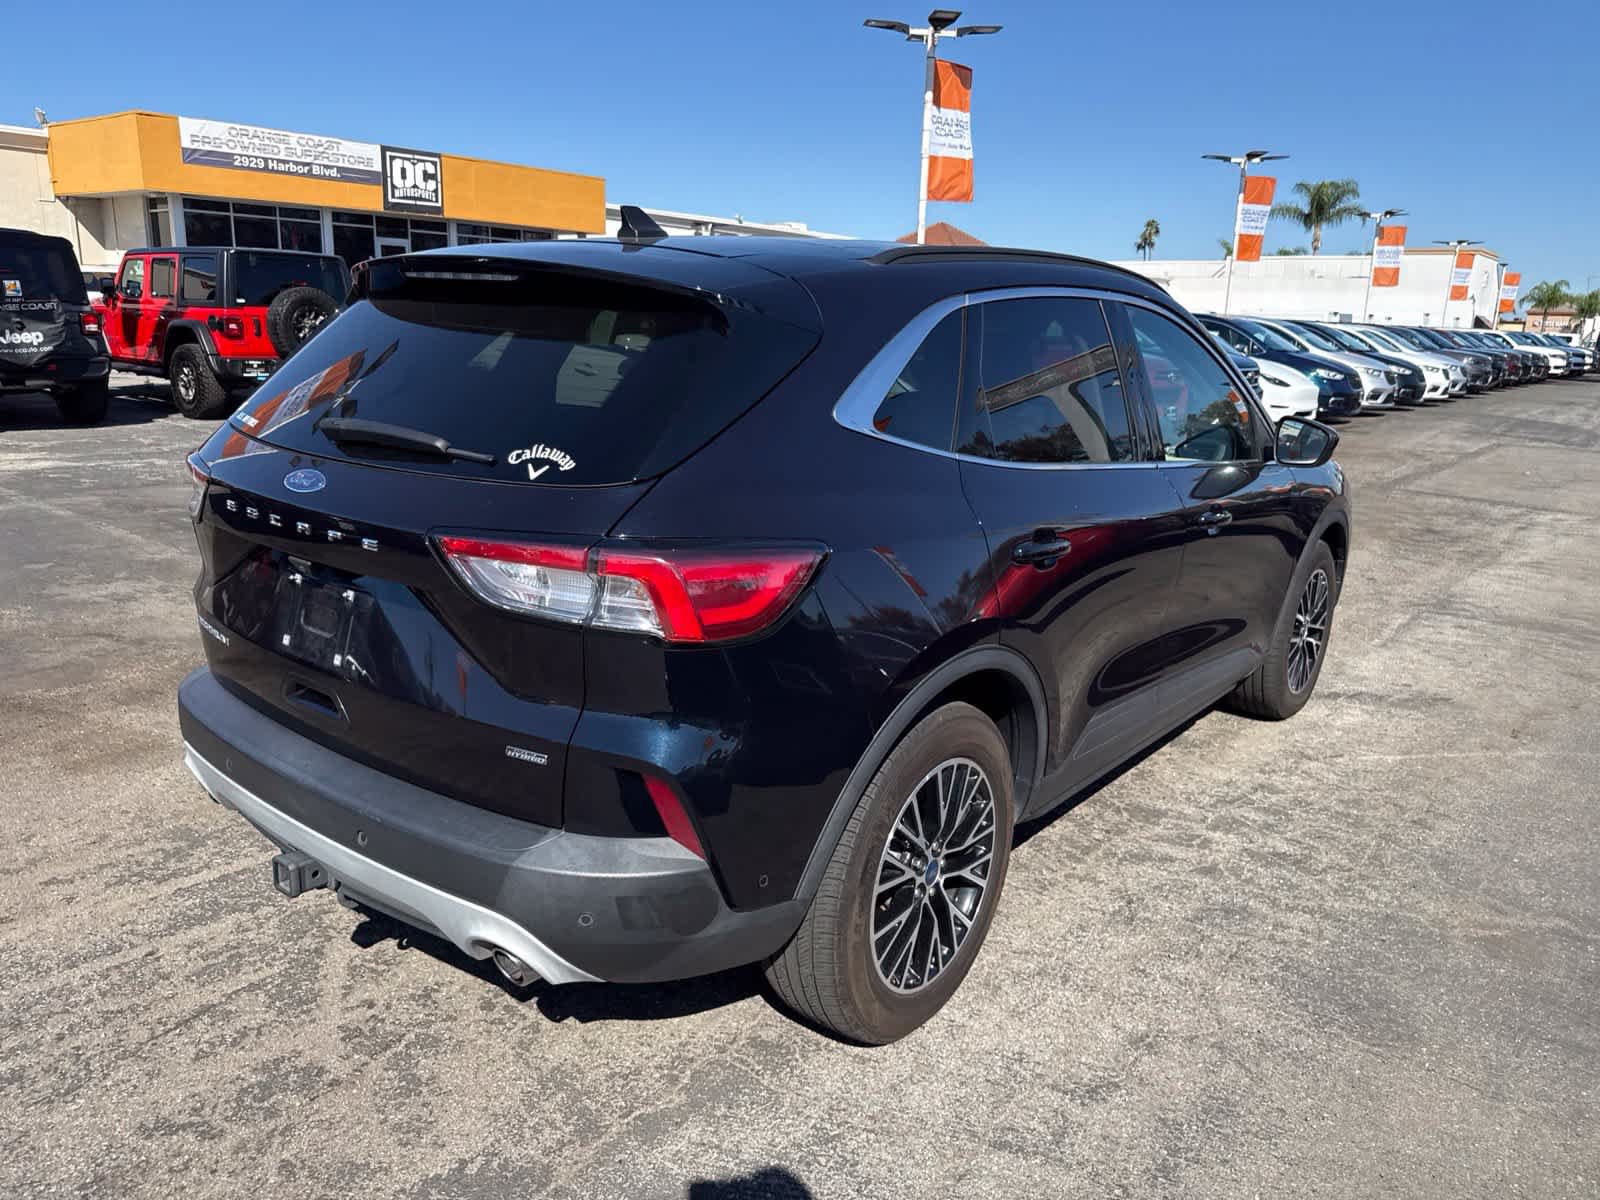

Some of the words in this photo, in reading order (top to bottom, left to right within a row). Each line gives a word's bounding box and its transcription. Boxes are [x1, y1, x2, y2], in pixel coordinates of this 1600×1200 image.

[189, 134, 281, 155] PRE-OWNED
[283, 146, 375, 168] SUPERSTORE
[227, 126, 291, 146] ORANGE
[296, 136, 342, 152] COAST
[233, 155, 265, 169] 2929
[268, 159, 309, 175] Harbor
[312, 163, 341, 178] Blvd.
[392, 158, 436, 192] OC
[21, 302, 58, 311] COAST
[0, 329, 44, 346] Jeep
[507, 443, 577, 472] Callaway
[226, 499, 379, 552] ESCAPE
